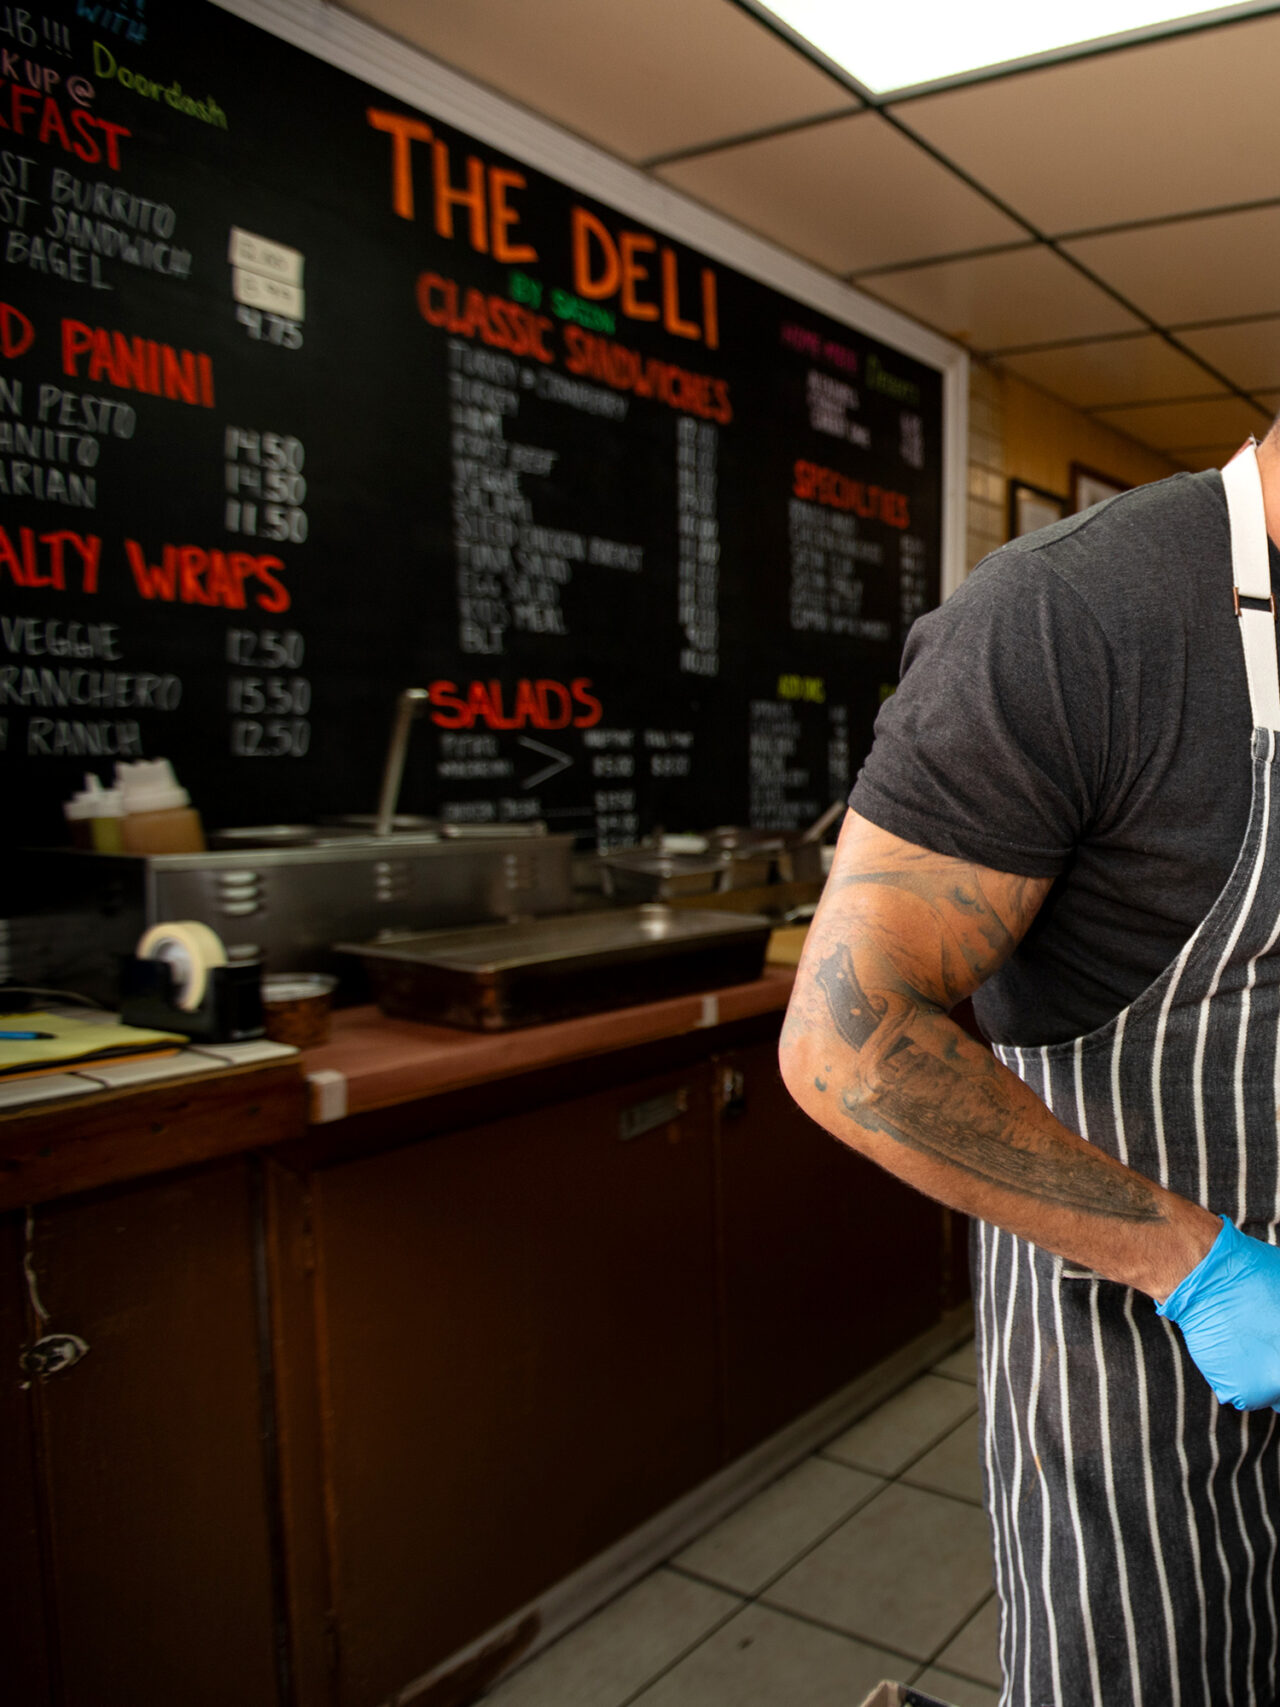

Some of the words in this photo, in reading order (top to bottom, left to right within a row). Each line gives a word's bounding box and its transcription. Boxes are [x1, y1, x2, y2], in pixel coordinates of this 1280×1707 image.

[24, 58, 61, 94] UP
[50, 167, 176, 239] BURRITO
[366, 107, 538, 263] THE
[572, 204, 719, 349] DELI
[5, 229, 114, 290] BAGEL
[44, 205, 192, 280] SANDWICH
[61, 318, 215, 408] PANINI
[417, 271, 555, 364] CLASSIC
[564, 324, 733, 424] SANDWICHES
[37, 382, 137, 440] PESTO
[124, 538, 291, 613] WRAPS
[1, 616, 123, 661] VEGGIE
[0, 666, 183, 711] RANCHERO
[428, 677, 603, 730] SALADS
[27, 717, 143, 757] RANCH
